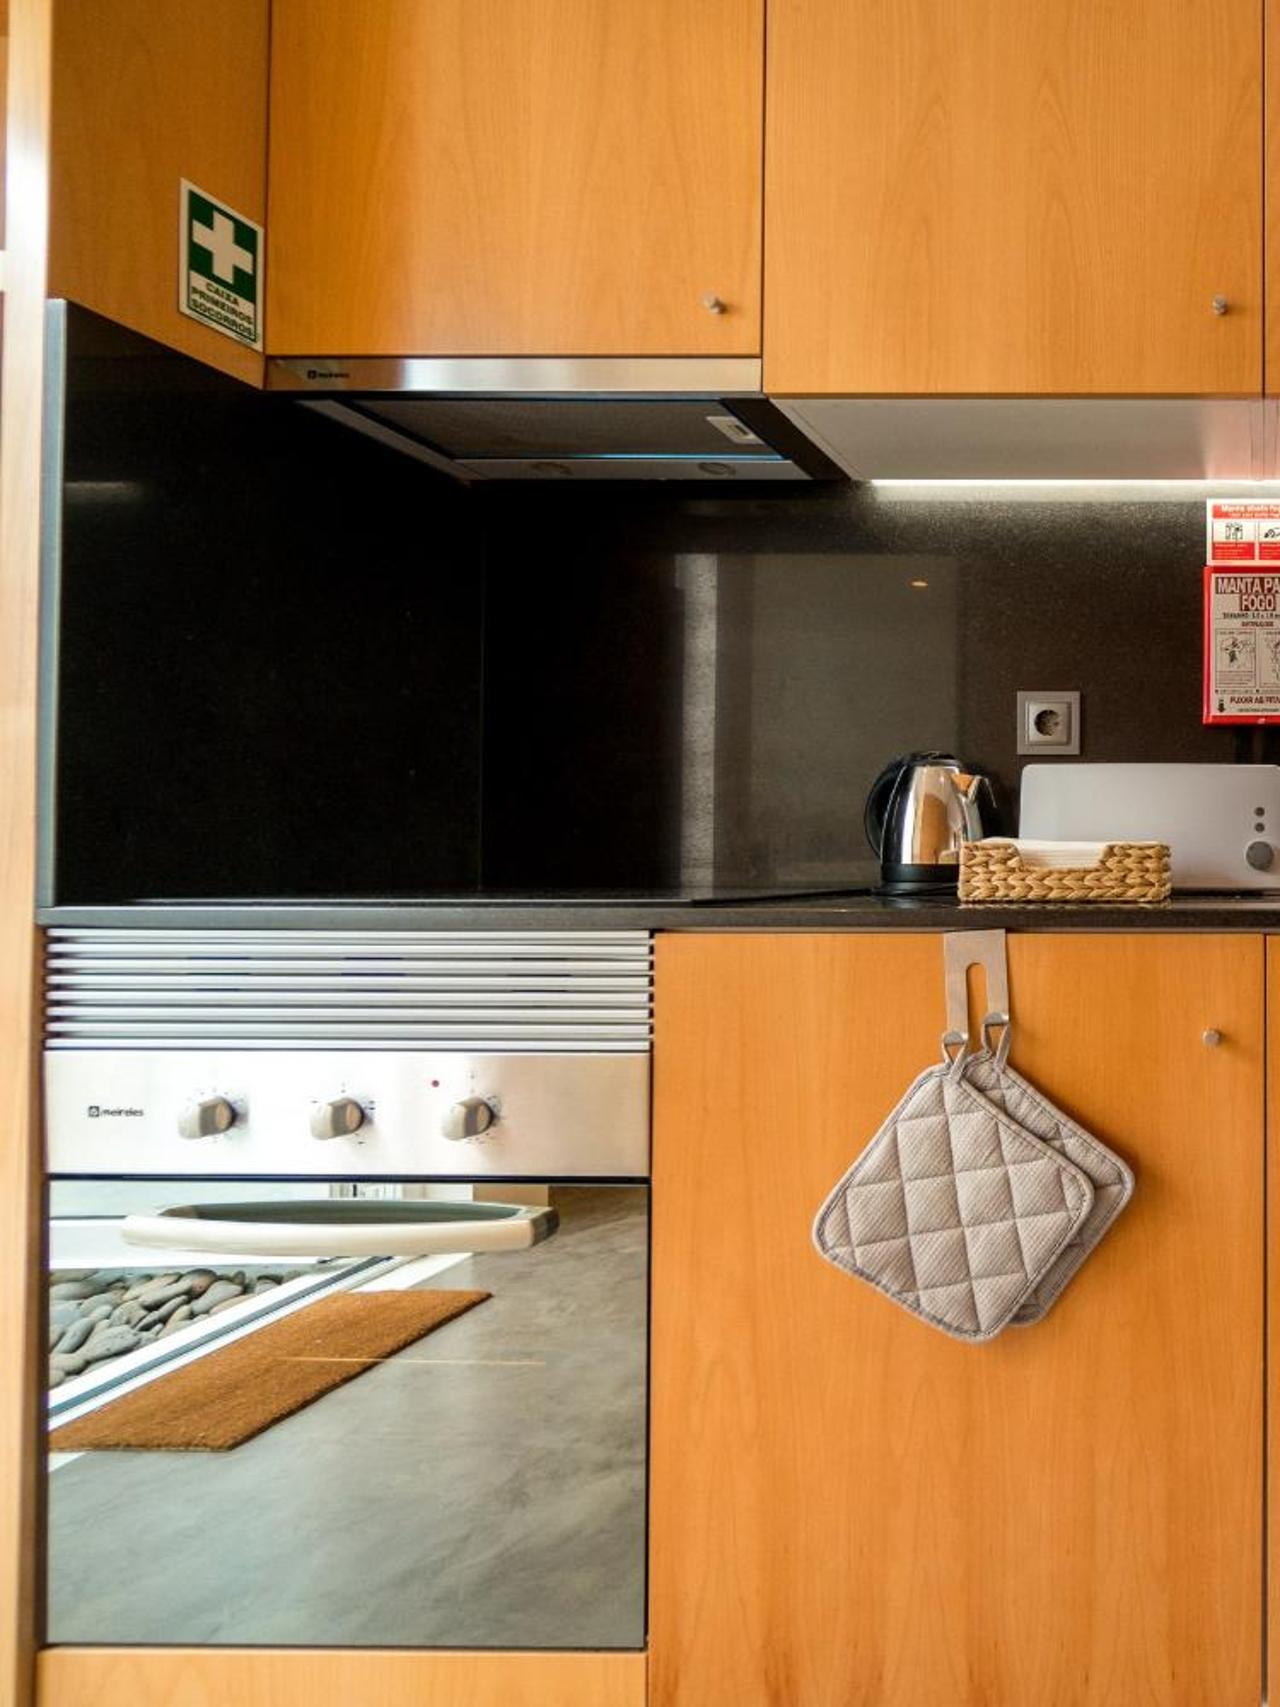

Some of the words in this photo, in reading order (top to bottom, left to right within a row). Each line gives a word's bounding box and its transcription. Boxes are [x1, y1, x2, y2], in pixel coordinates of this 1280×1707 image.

[191, 286, 254, 325] PRIMEIROS
[206, 281, 239, 306] CAIXA
[191, 298, 254, 337] SOCORROS
[1217, 578, 1261, 593] MANTA
[1241, 595, 1275, 611] FOGO
